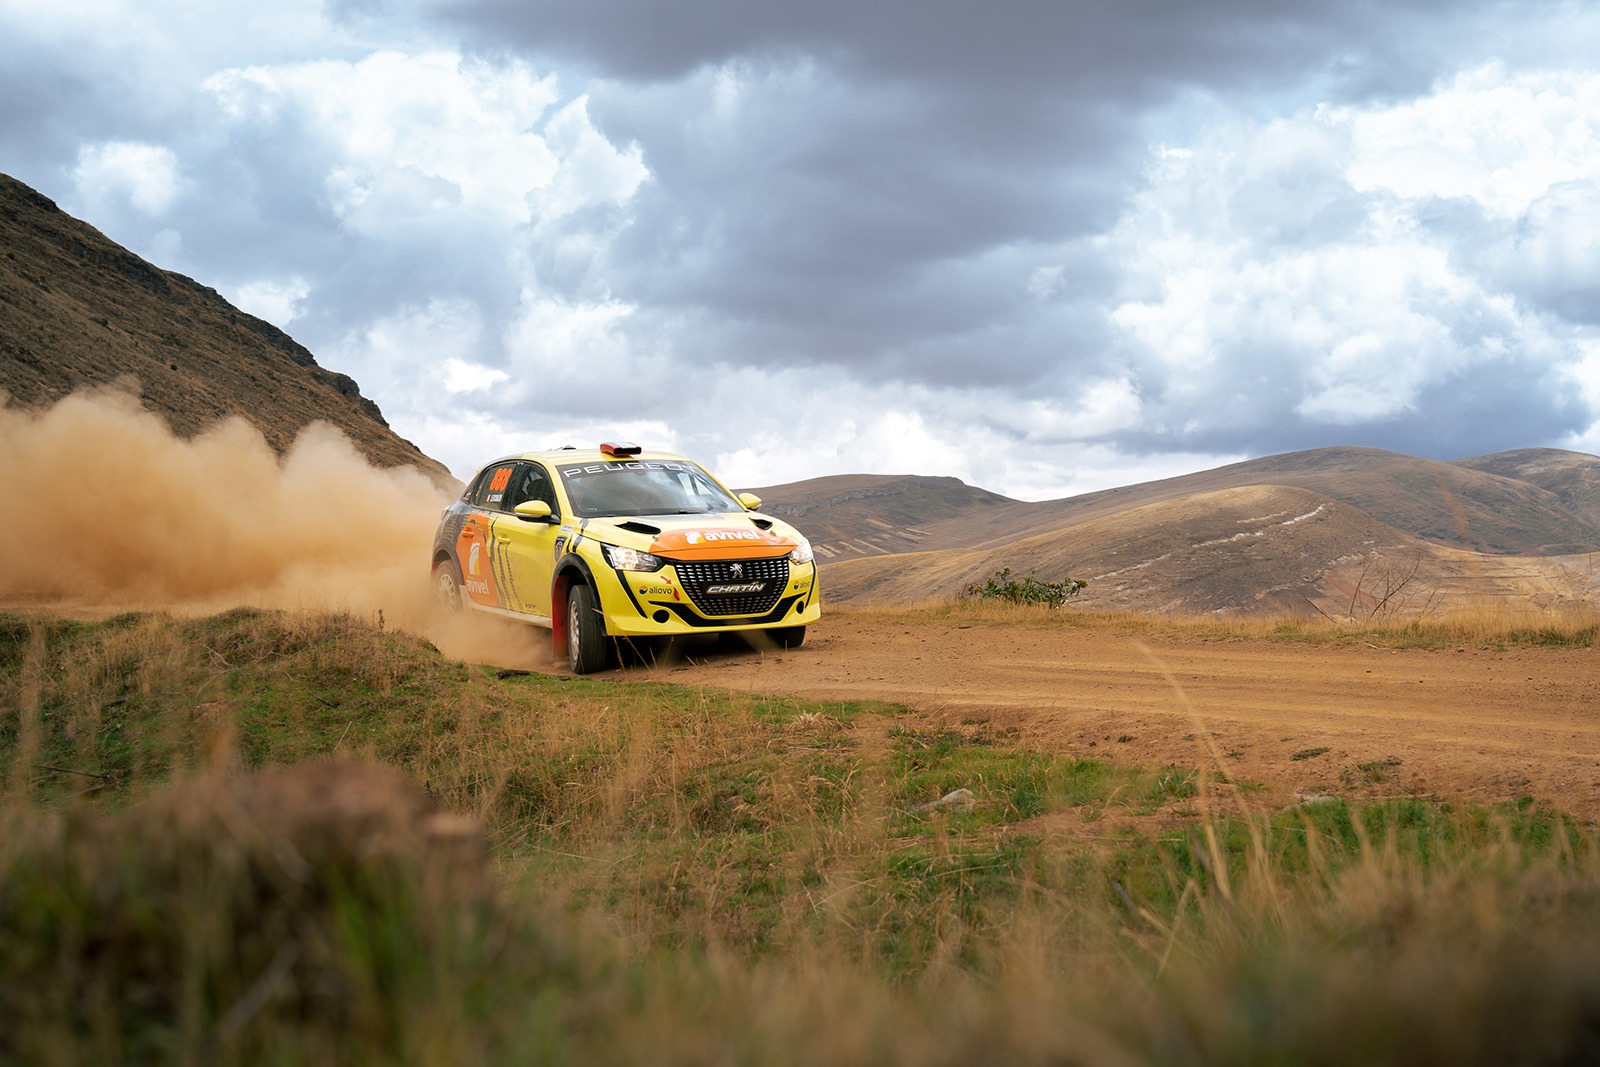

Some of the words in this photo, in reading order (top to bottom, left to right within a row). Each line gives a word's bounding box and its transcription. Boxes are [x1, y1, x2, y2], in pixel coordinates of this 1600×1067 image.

[563, 462, 696, 478] PEUGEOT
[489, 467, 513, 491] 888
[704, 531, 761, 541] avivel
[649, 586, 673, 595] aliovo
